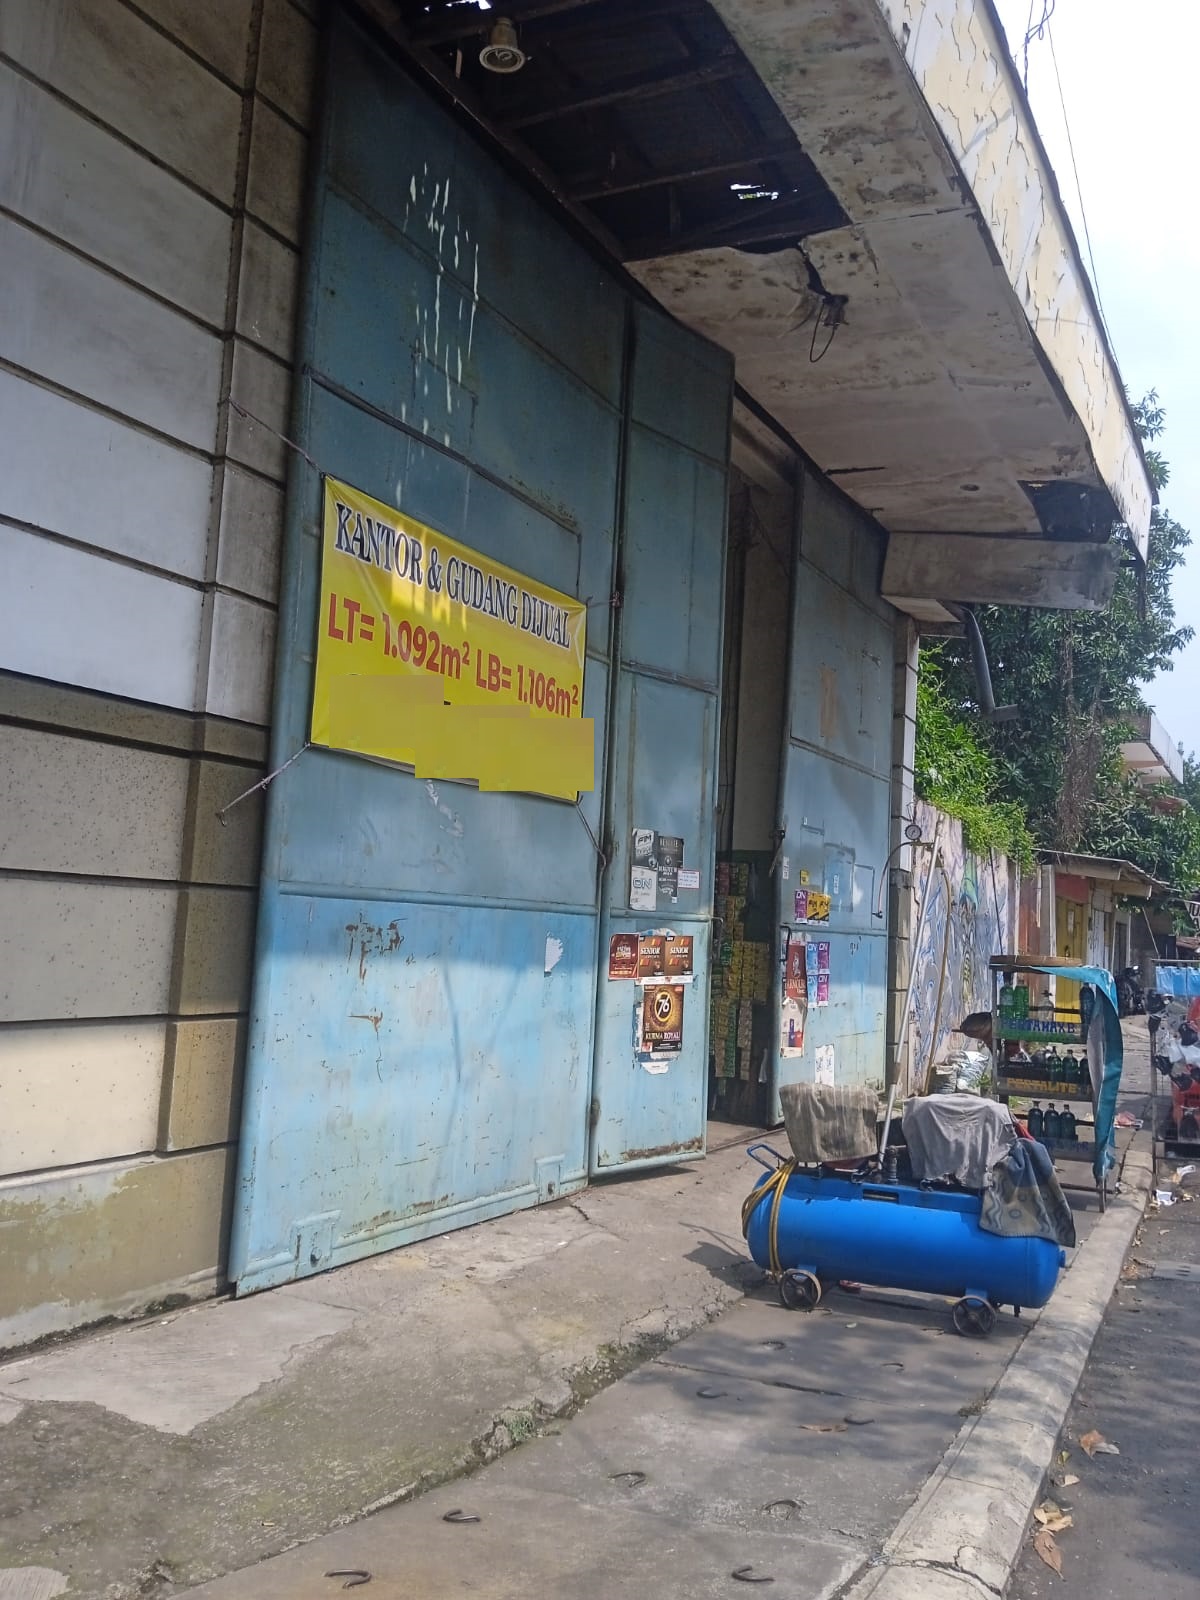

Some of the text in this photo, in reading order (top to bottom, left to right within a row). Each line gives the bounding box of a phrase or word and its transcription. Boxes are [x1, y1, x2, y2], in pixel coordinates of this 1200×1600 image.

[335, 502, 570, 649] KANTOR & GUDANG DIJUAL
[328, 592, 375, 643] LT=
[476, 649, 512, 692] LB=
[657, 996, 670, 1017] 76
